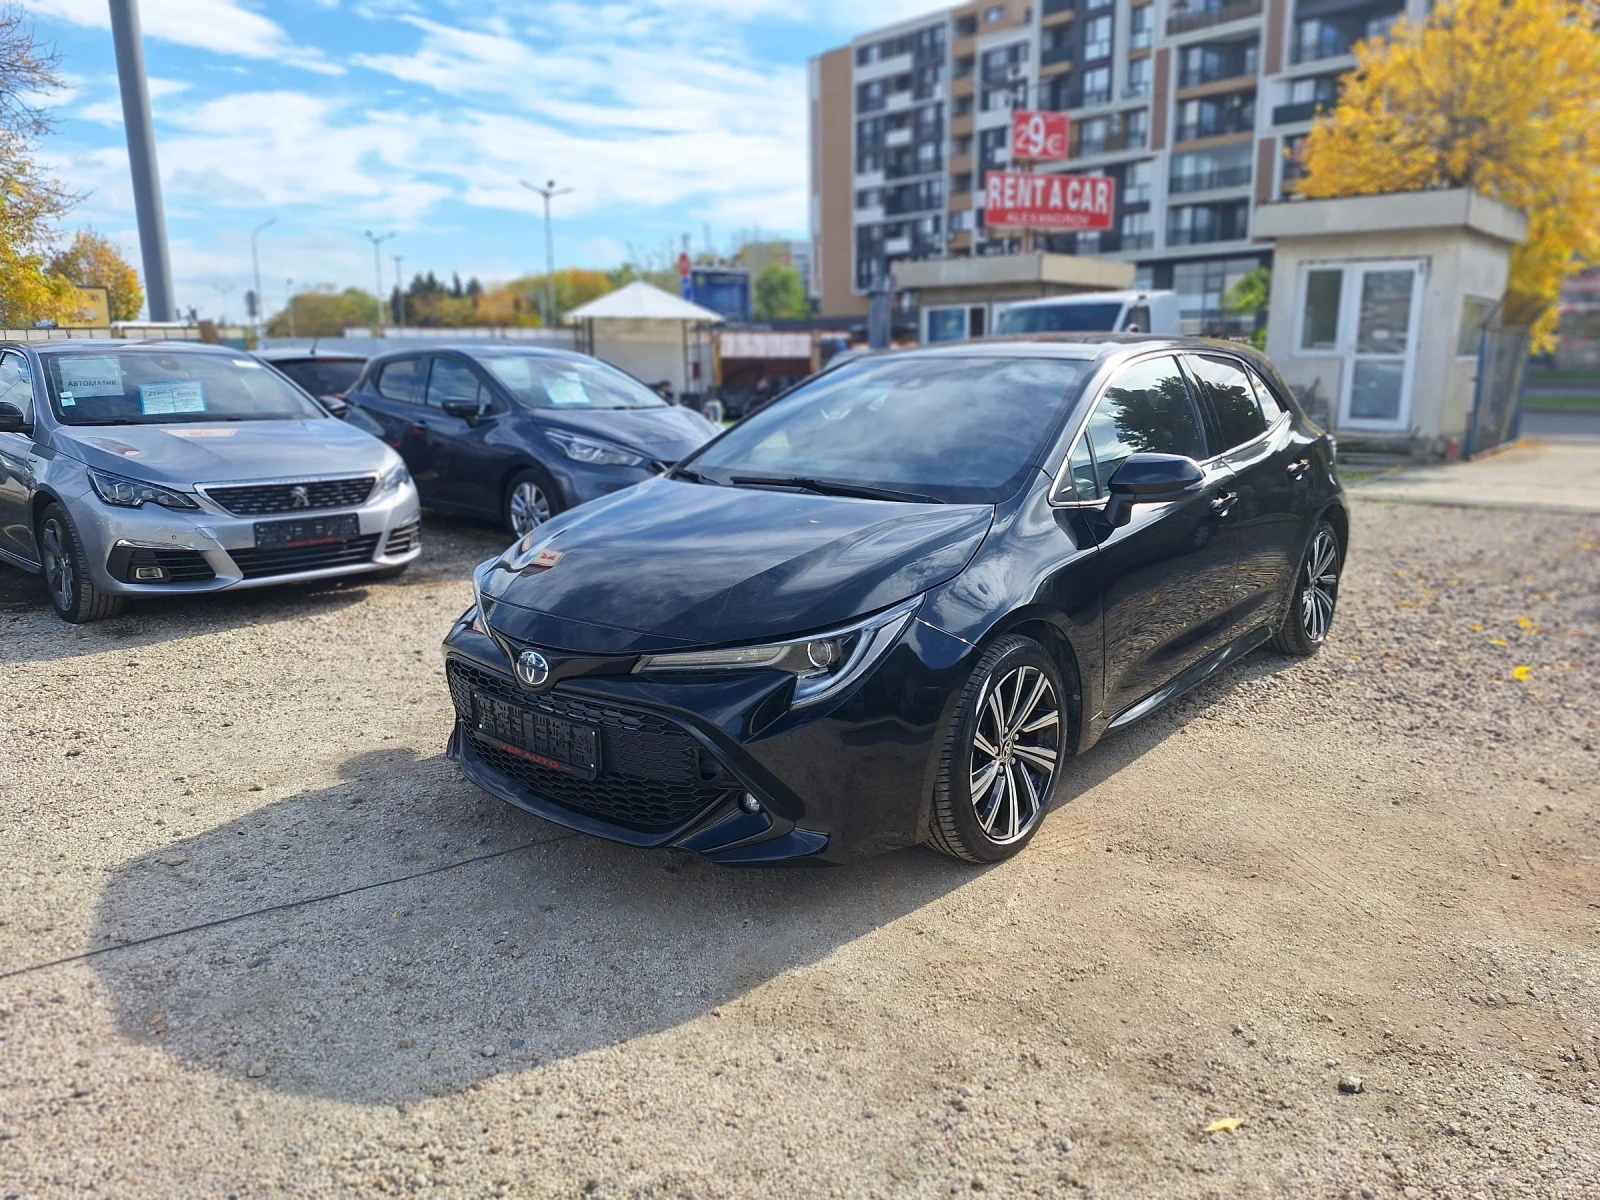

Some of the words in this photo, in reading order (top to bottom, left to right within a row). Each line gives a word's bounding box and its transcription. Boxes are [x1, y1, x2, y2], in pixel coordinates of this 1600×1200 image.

[988, 176, 1045, 208] RENT
[1048, 179, 1064, 209] A
[1066, 180, 1109, 215] CAR
[67, 379, 117, 388] АВТОМАТИК
[523, 751, 560, 768] AUTO
